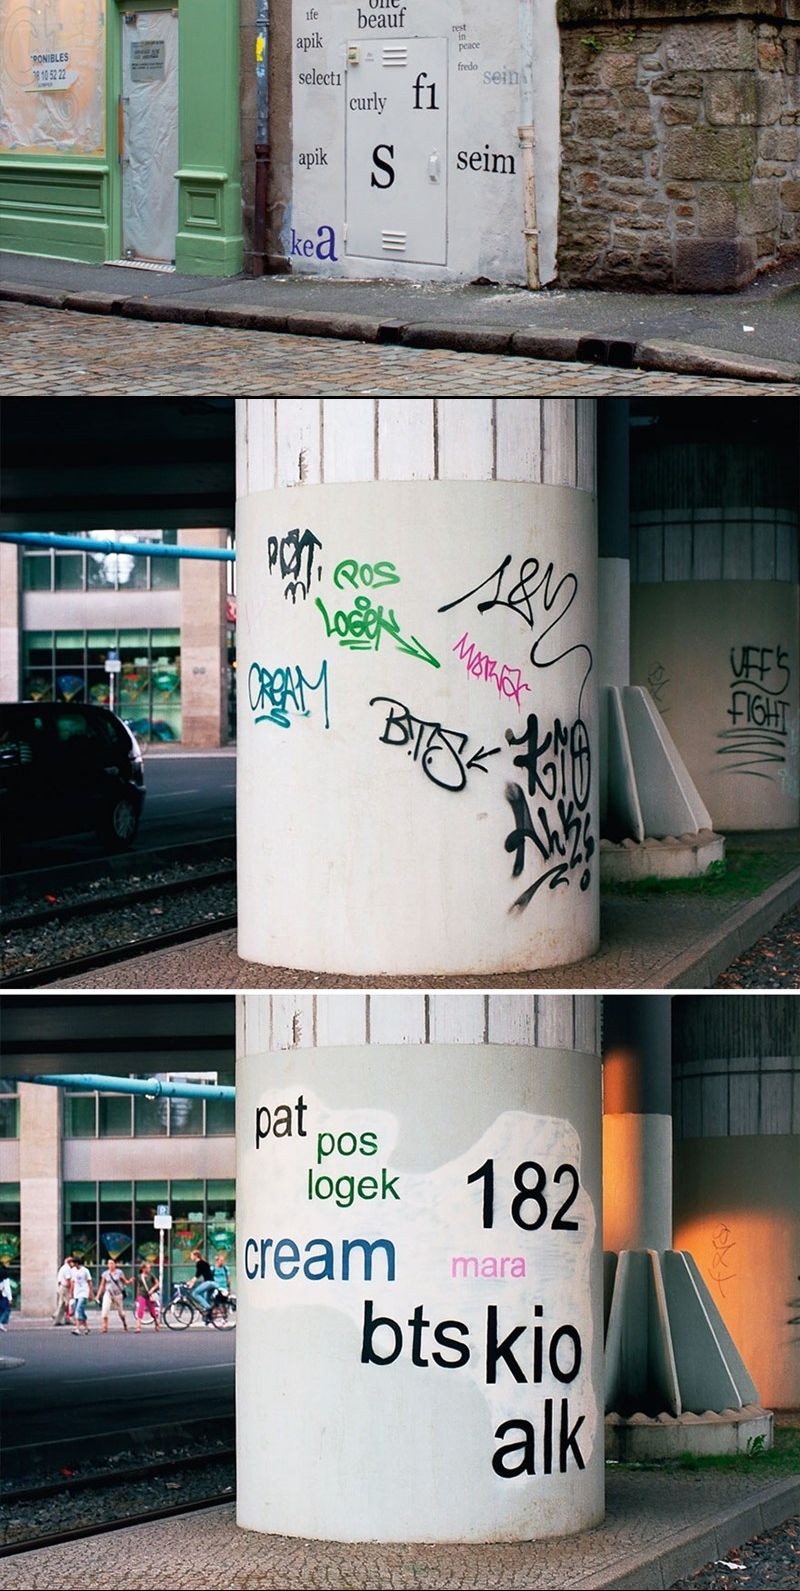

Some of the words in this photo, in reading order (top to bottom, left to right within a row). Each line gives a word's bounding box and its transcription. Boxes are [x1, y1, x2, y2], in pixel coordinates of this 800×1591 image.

[357, 7, 406, 29] beauf
[452, 24, 466, 33] rest
[296, 33, 323, 52] apik
[457, 61, 478, 71] fredo
[349, 92, 387, 115] curly
[298, 148, 328, 169] apik
[456, 144, 517, 175] seim
[255, 1095, 308, 1149] pat
[316, 1130, 378, 1164] pos
[307, 1168, 401, 1208] logek
[466, 1158, 580, 1231] 182
[244, 1237, 396, 1281] cream
[451, 1254, 527, 1278] mara
[361, 1300, 471, 1368] bts
[485, 1305, 583, 1385] kio
[491, 1398, 587, 1479] alk
